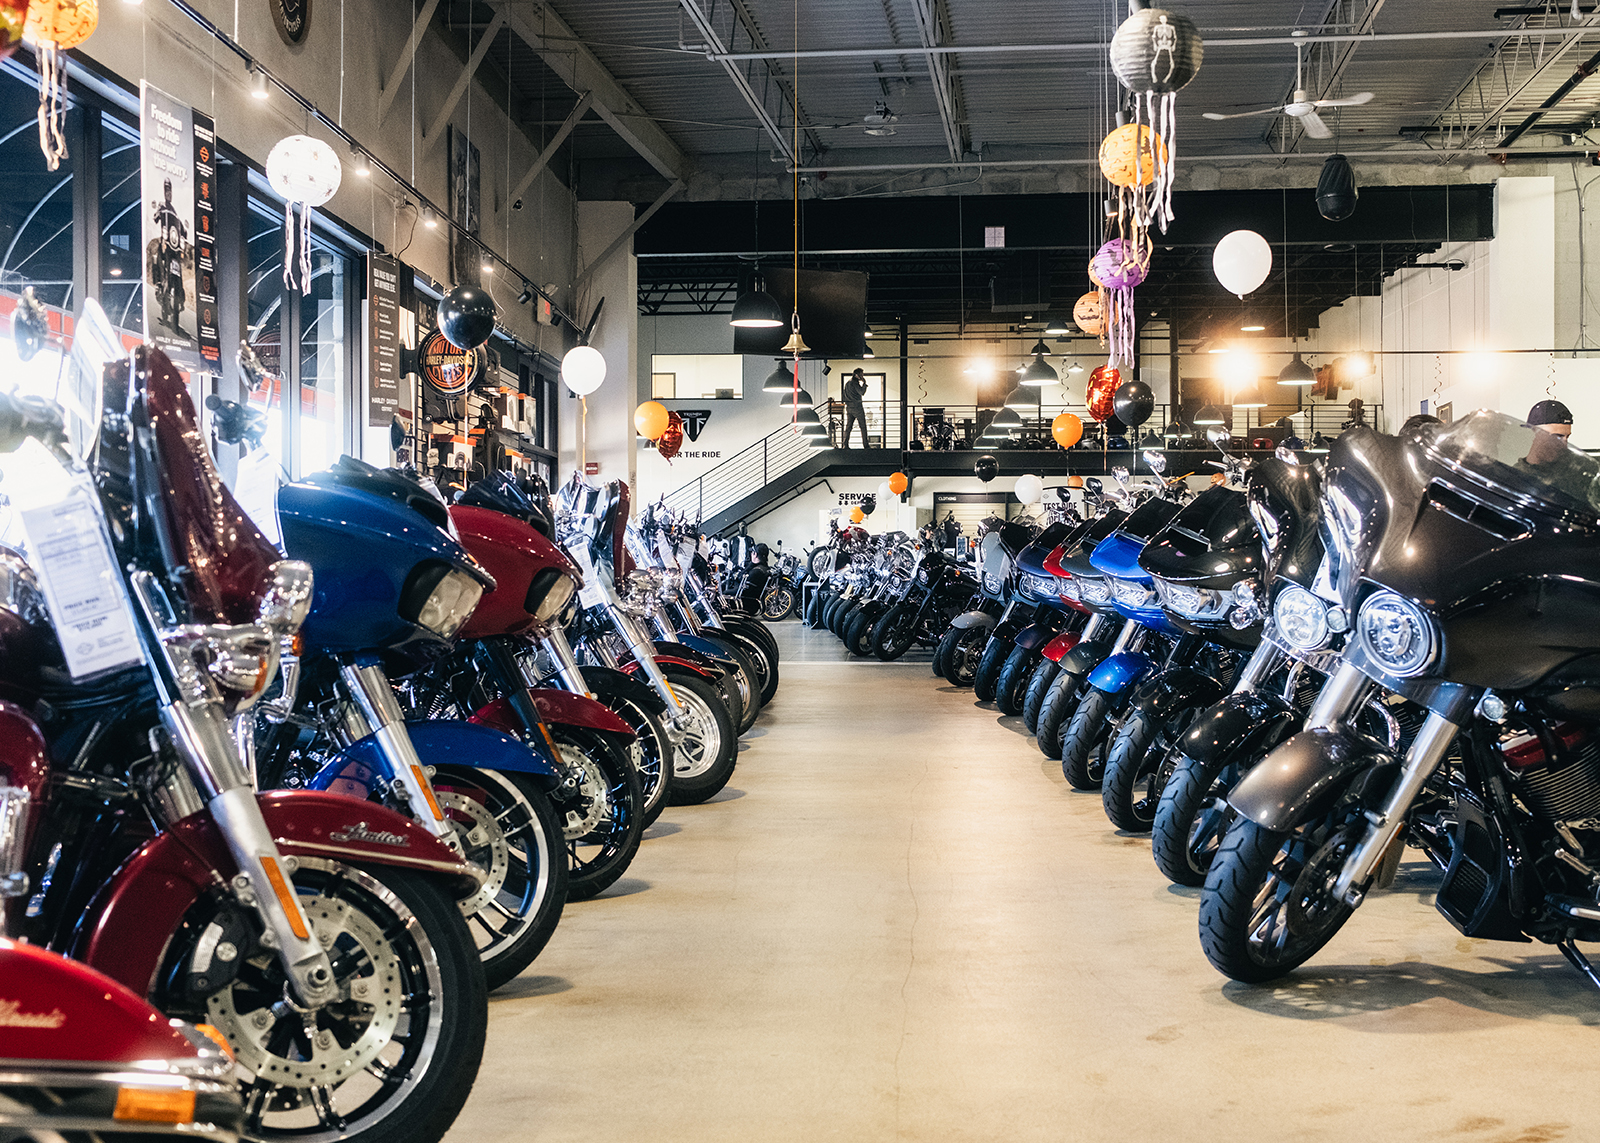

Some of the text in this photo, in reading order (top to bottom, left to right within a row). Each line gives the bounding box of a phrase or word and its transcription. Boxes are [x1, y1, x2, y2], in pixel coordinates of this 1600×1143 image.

[151, 103, 183, 132] Freedom
[157, 123, 166, 139] to
[166, 128, 180, 146] ride
[149, 137, 177, 160] without
[153, 153, 167, 171] the
[167, 161, 188, 182] worry.
[426, 355, 473, 365] HARLEY-DAVIDSN
